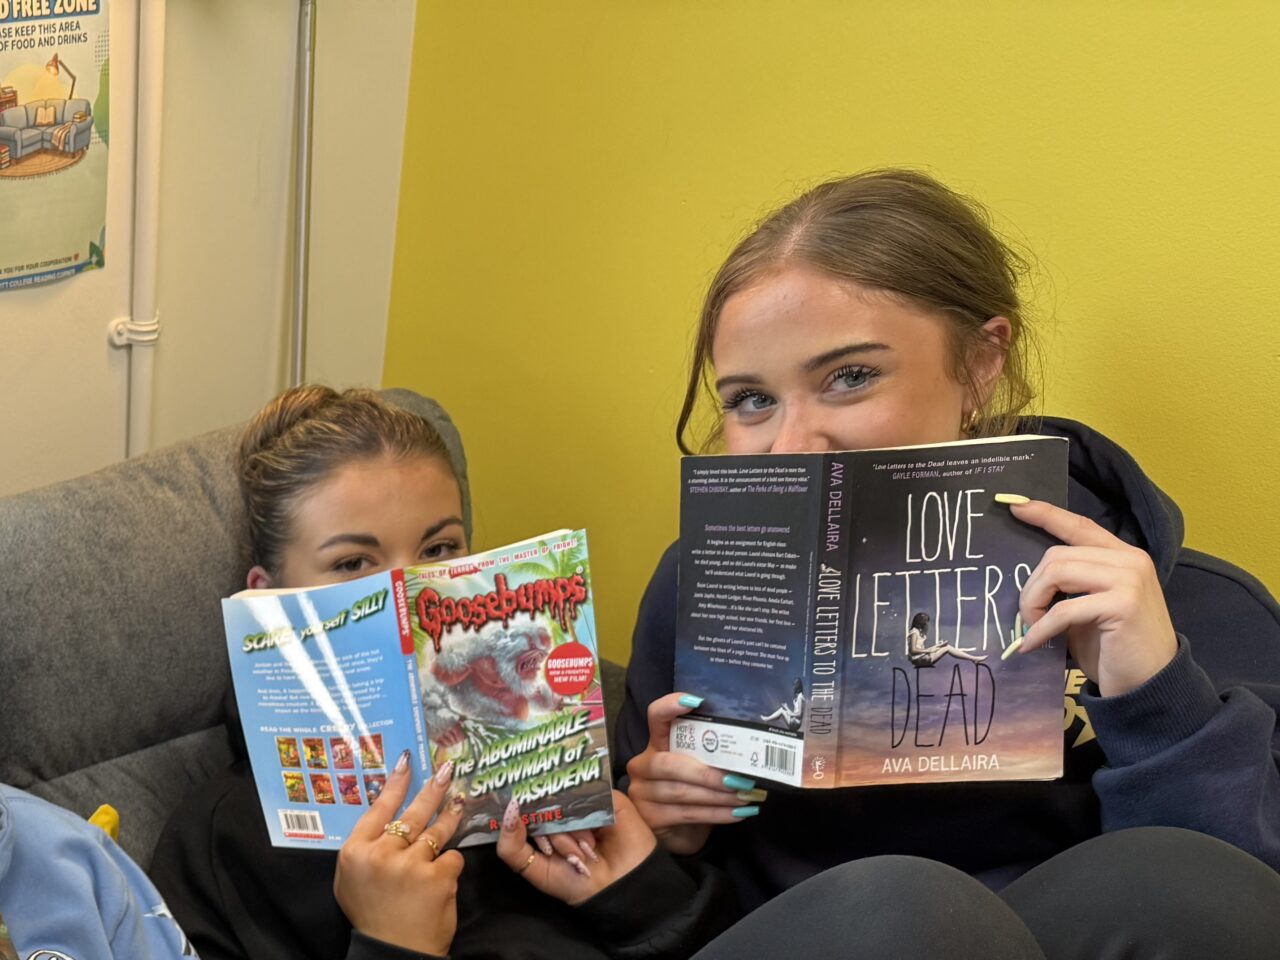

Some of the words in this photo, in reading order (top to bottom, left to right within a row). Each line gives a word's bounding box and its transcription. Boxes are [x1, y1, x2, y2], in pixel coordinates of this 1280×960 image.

[12, 0, 51, 18] FREE
[14, 25, 36, 37] KEEP
[38, 22, 57, 35] THIS
[58, 20, 81, 32] AREA
[11, 38, 36, 52] FOOD
[37, 36, 56, 48] AND
[57, 32, 88, 46] DRINKS
[892, 472, 910, 480] GAYLE
[911, 470, 941, 479] FORMAN,
[942, 470, 964, 478] author
[964, 468, 972, 476] of
[987, 465, 1006, 474] STAY
[927, 460, 946, 468] Dead
[946, 459, 969, 467] leaves
[980, 456, 1011, 464] indelible
[830, 462, 844, 487] AVA
[826, 490, 842, 552] DELLAIRA
[905, 488, 986, 563] LOVE
[477, 560, 495, 568] FROM
[514, 549, 538, 561] MASTER
[542, 546, 550, 555] OF
[817, 572, 842, 602] LOVE
[300, 609, 350, 642] yourself
[351, 588, 388, 622] SILLY
[394, 580, 410, 637] GOOSEBUMPS
[416, 573, 587, 652] Goosebumps
[814, 606, 840, 656] LETTERS
[547, 656, 593, 669] GOOSEBUMPS
[812, 660, 836, 676] TO
[810, 680, 835, 701] THE
[891, 662, 996, 749] DEAD
[676, 724, 688, 732] HOT
[810, 706, 833, 736] DEAD
[477, 710, 590, 771] ABOMINABLE
[676, 741, 696, 750] BOOKS
[470, 744, 564, 798] SNOWMAN
[564, 734, 588, 764] of
[881, 757, 913, 774] AVA
[918, 754, 1000, 772] DELLAIRA
[512, 756, 602, 806] PASADENA
[520, 808, 564, 826] STINE
